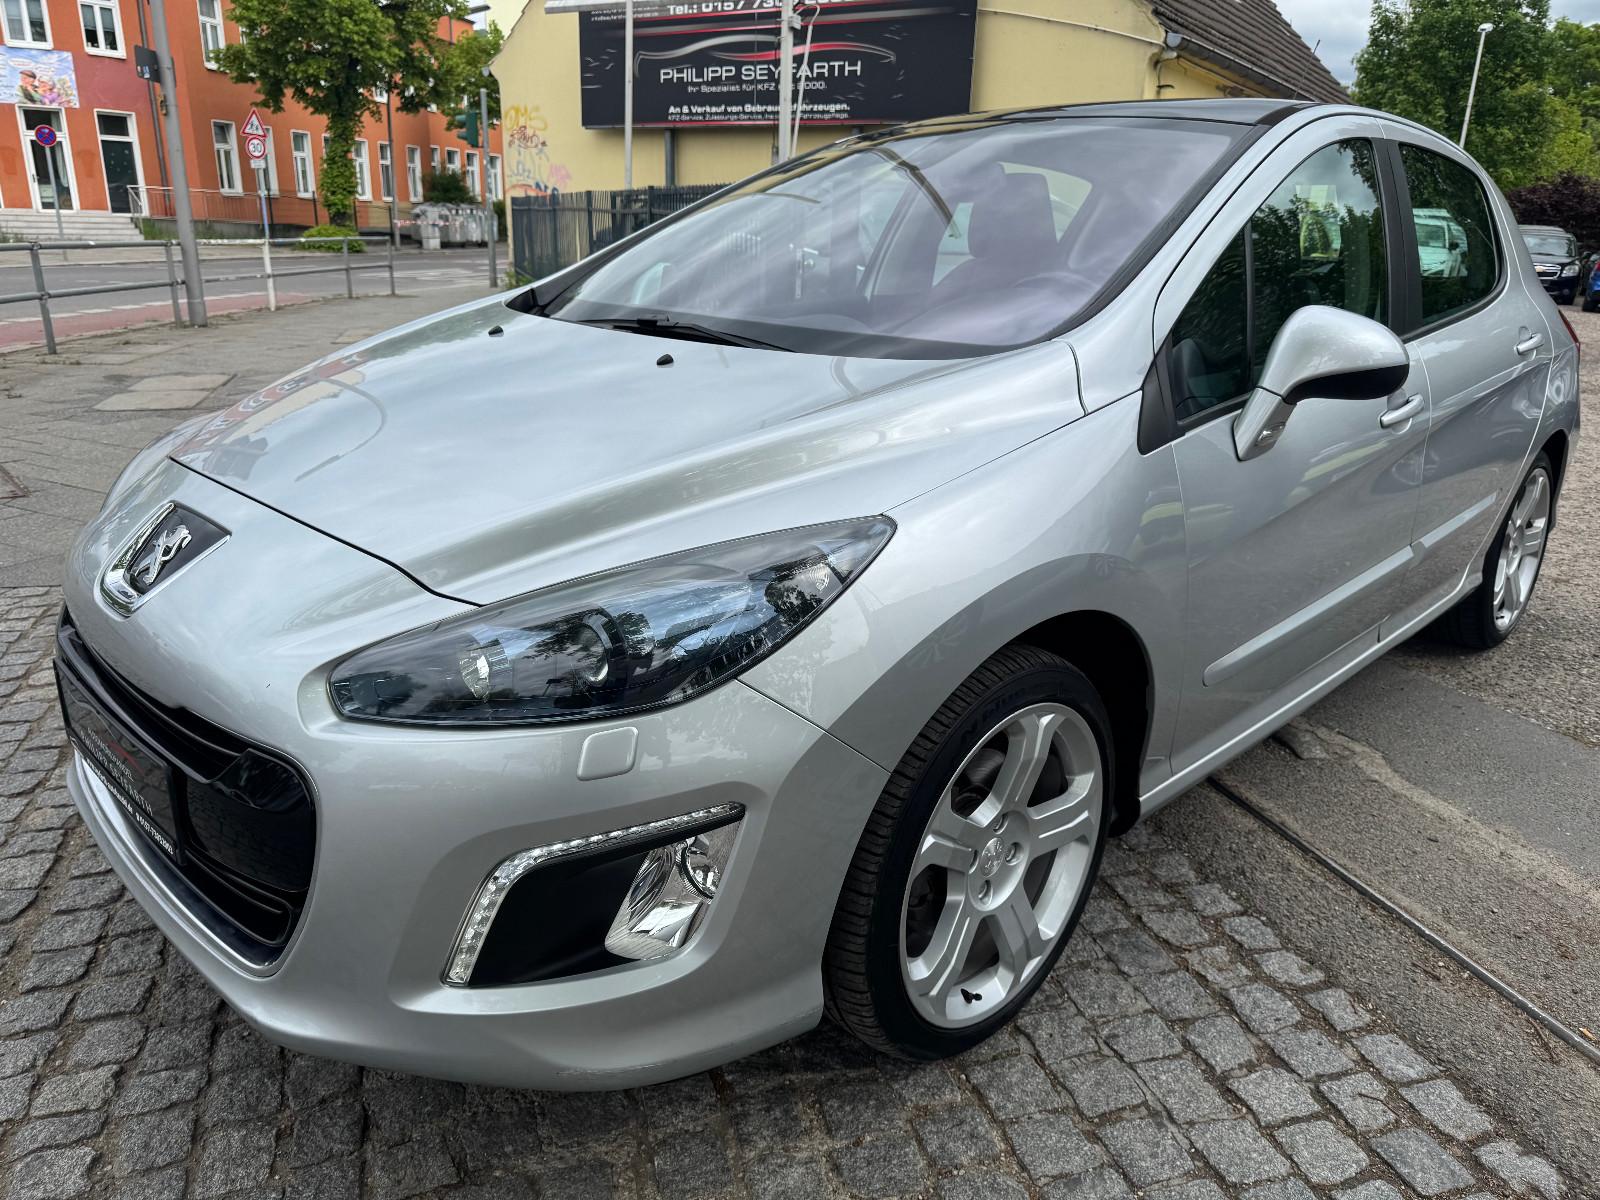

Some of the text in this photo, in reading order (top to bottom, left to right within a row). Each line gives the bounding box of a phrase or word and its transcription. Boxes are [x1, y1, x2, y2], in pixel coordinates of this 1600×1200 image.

[667, 5, 697, 15] Tel.:
[660, 65, 736, 83] PHILIPP
[687, 85, 699, 93] Ihr
[700, 83, 740, 93] Spezialist
[742, 83, 755, 91] für
[757, 82, 775, 91] KFZ
[668, 105, 680, 114] An
[690, 104, 725, 114] Verkauf
[727, 105, 743, 113] von
[250, 142, 262, 153] 30
